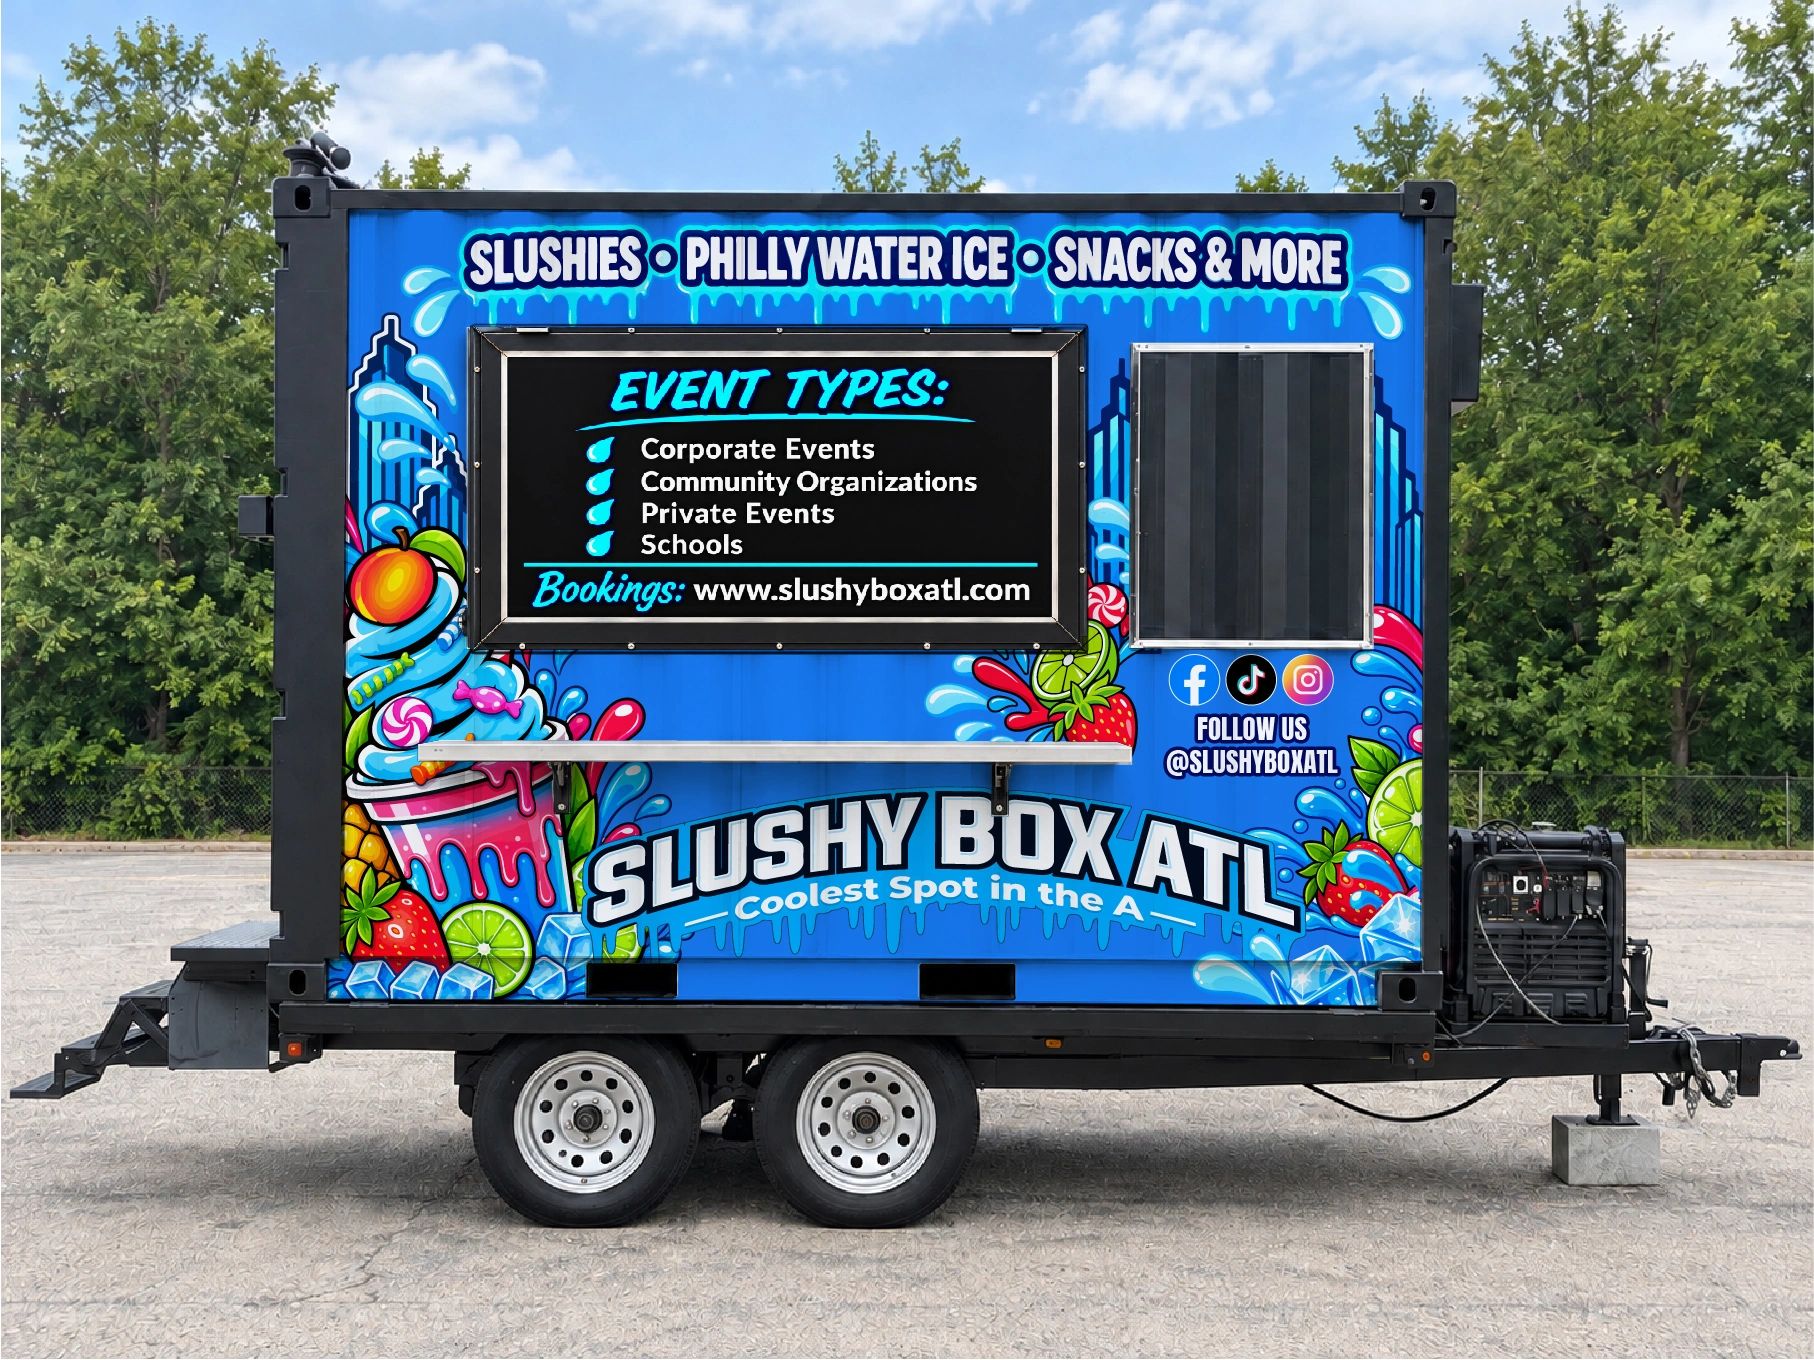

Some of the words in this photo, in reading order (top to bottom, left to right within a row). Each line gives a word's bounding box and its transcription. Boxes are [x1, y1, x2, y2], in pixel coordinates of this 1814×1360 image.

[470, 235, 642, 286] SLUSHIES
[686, 236, 810, 280] PHILLY
[816, 236, 942, 280] WATER
[952, 235, 1008, 280] ICE
[1054, 236, 1197, 283] SNACKS
[1205, 236, 1232, 282] &
[1241, 237, 1342, 284] MORE
[610, 369, 771, 412] EVENT
[786, 368, 950, 410] TYPES:
[641, 437, 776, 463] Corporate
[786, 437, 875, 460] Events
[641, 470, 791, 495] Community
[797, 470, 978, 496] Organizations
[641, 502, 737, 524] Private
[746, 502, 835, 524] Events
[641, 533, 743, 555] Schools
[532, 570, 686, 612] Bookings:
[693, 577, 1030, 606] www.slushyboxatl.com
[1197, 716, 1275, 741] FOLLOW
[1281, 716, 1307, 741] US
[1166, 749, 1338, 776] @SLUSHYBOXATL
[593, 797, 922, 923] SLUSHY
[941, 795, 1116, 881] BOX
[1133, 820, 1295, 926] ATL
[734, 879, 879, 920] Coolest
[889, 875, 978, 904] Spot
[991, 874, 1026, 901] in
[1038, 883, 1103, 912] the
[1112, 895, 1145, 921] A
